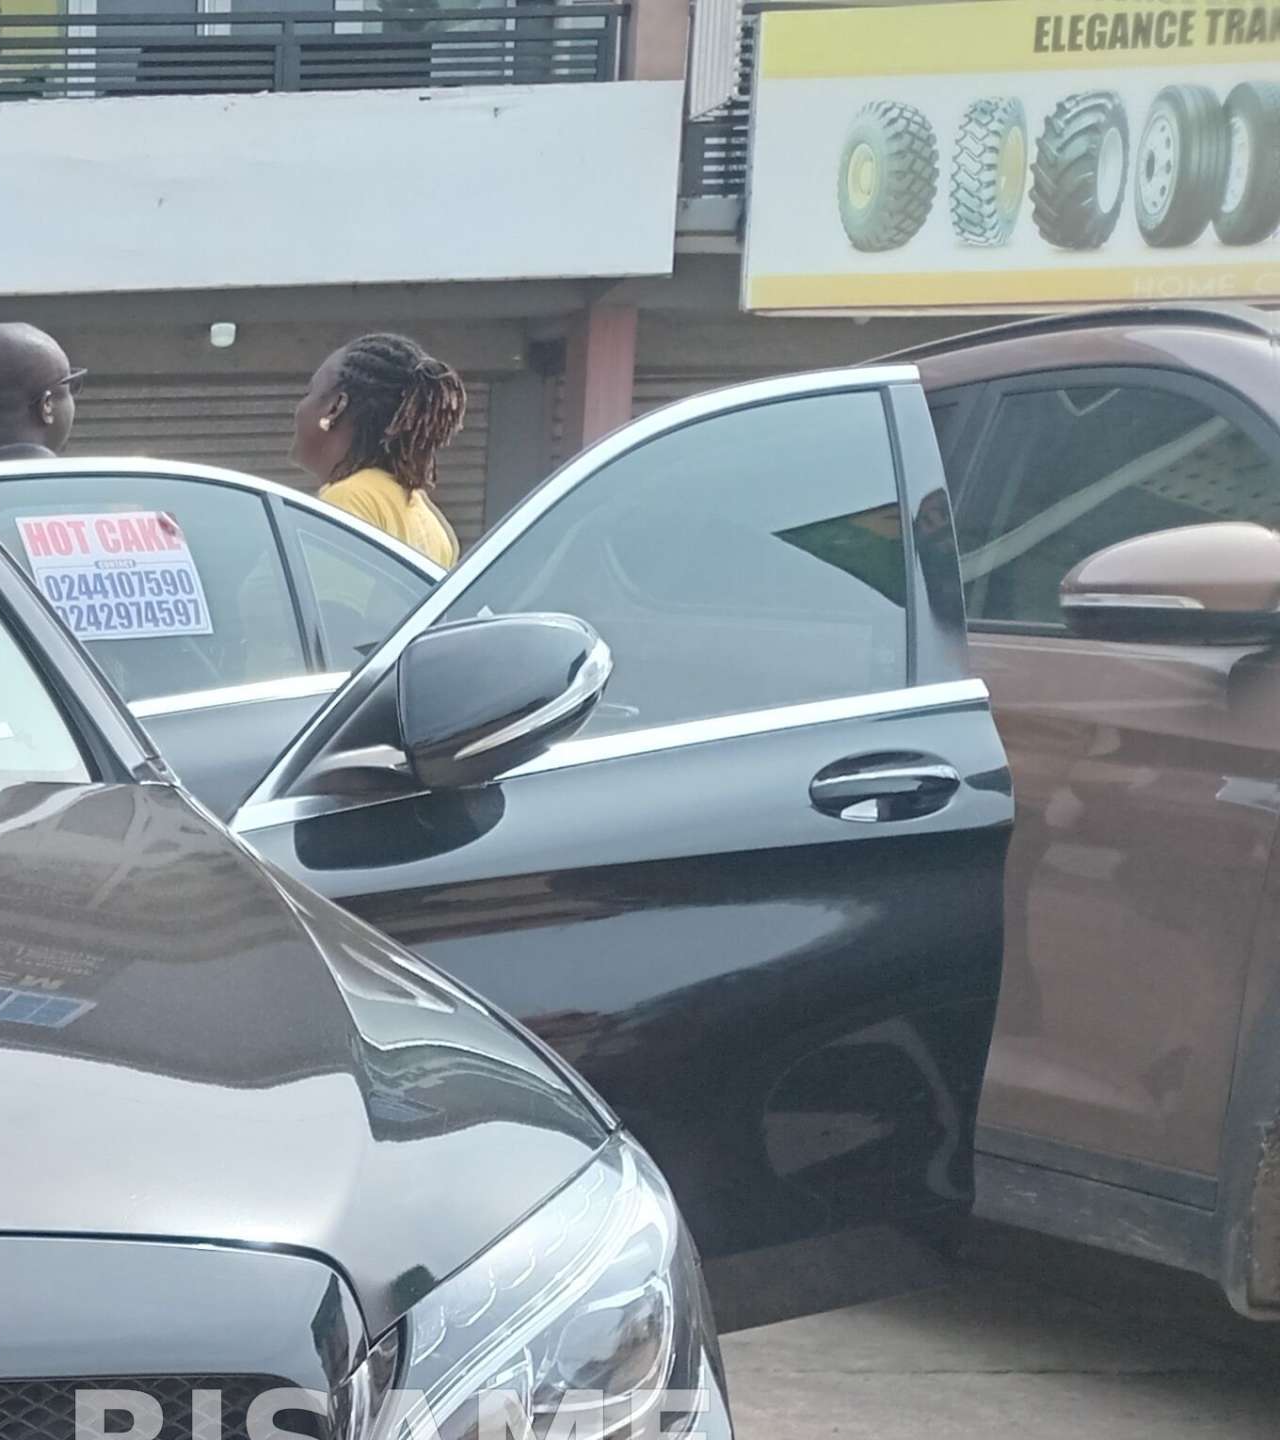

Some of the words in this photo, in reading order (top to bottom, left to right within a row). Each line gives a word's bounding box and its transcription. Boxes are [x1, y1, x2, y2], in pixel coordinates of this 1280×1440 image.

[1033, 10, 1196, 53] ELEGANCE
[23, 520, 90, 557] HOT
[44, 569, 195, 602] 0244107590
